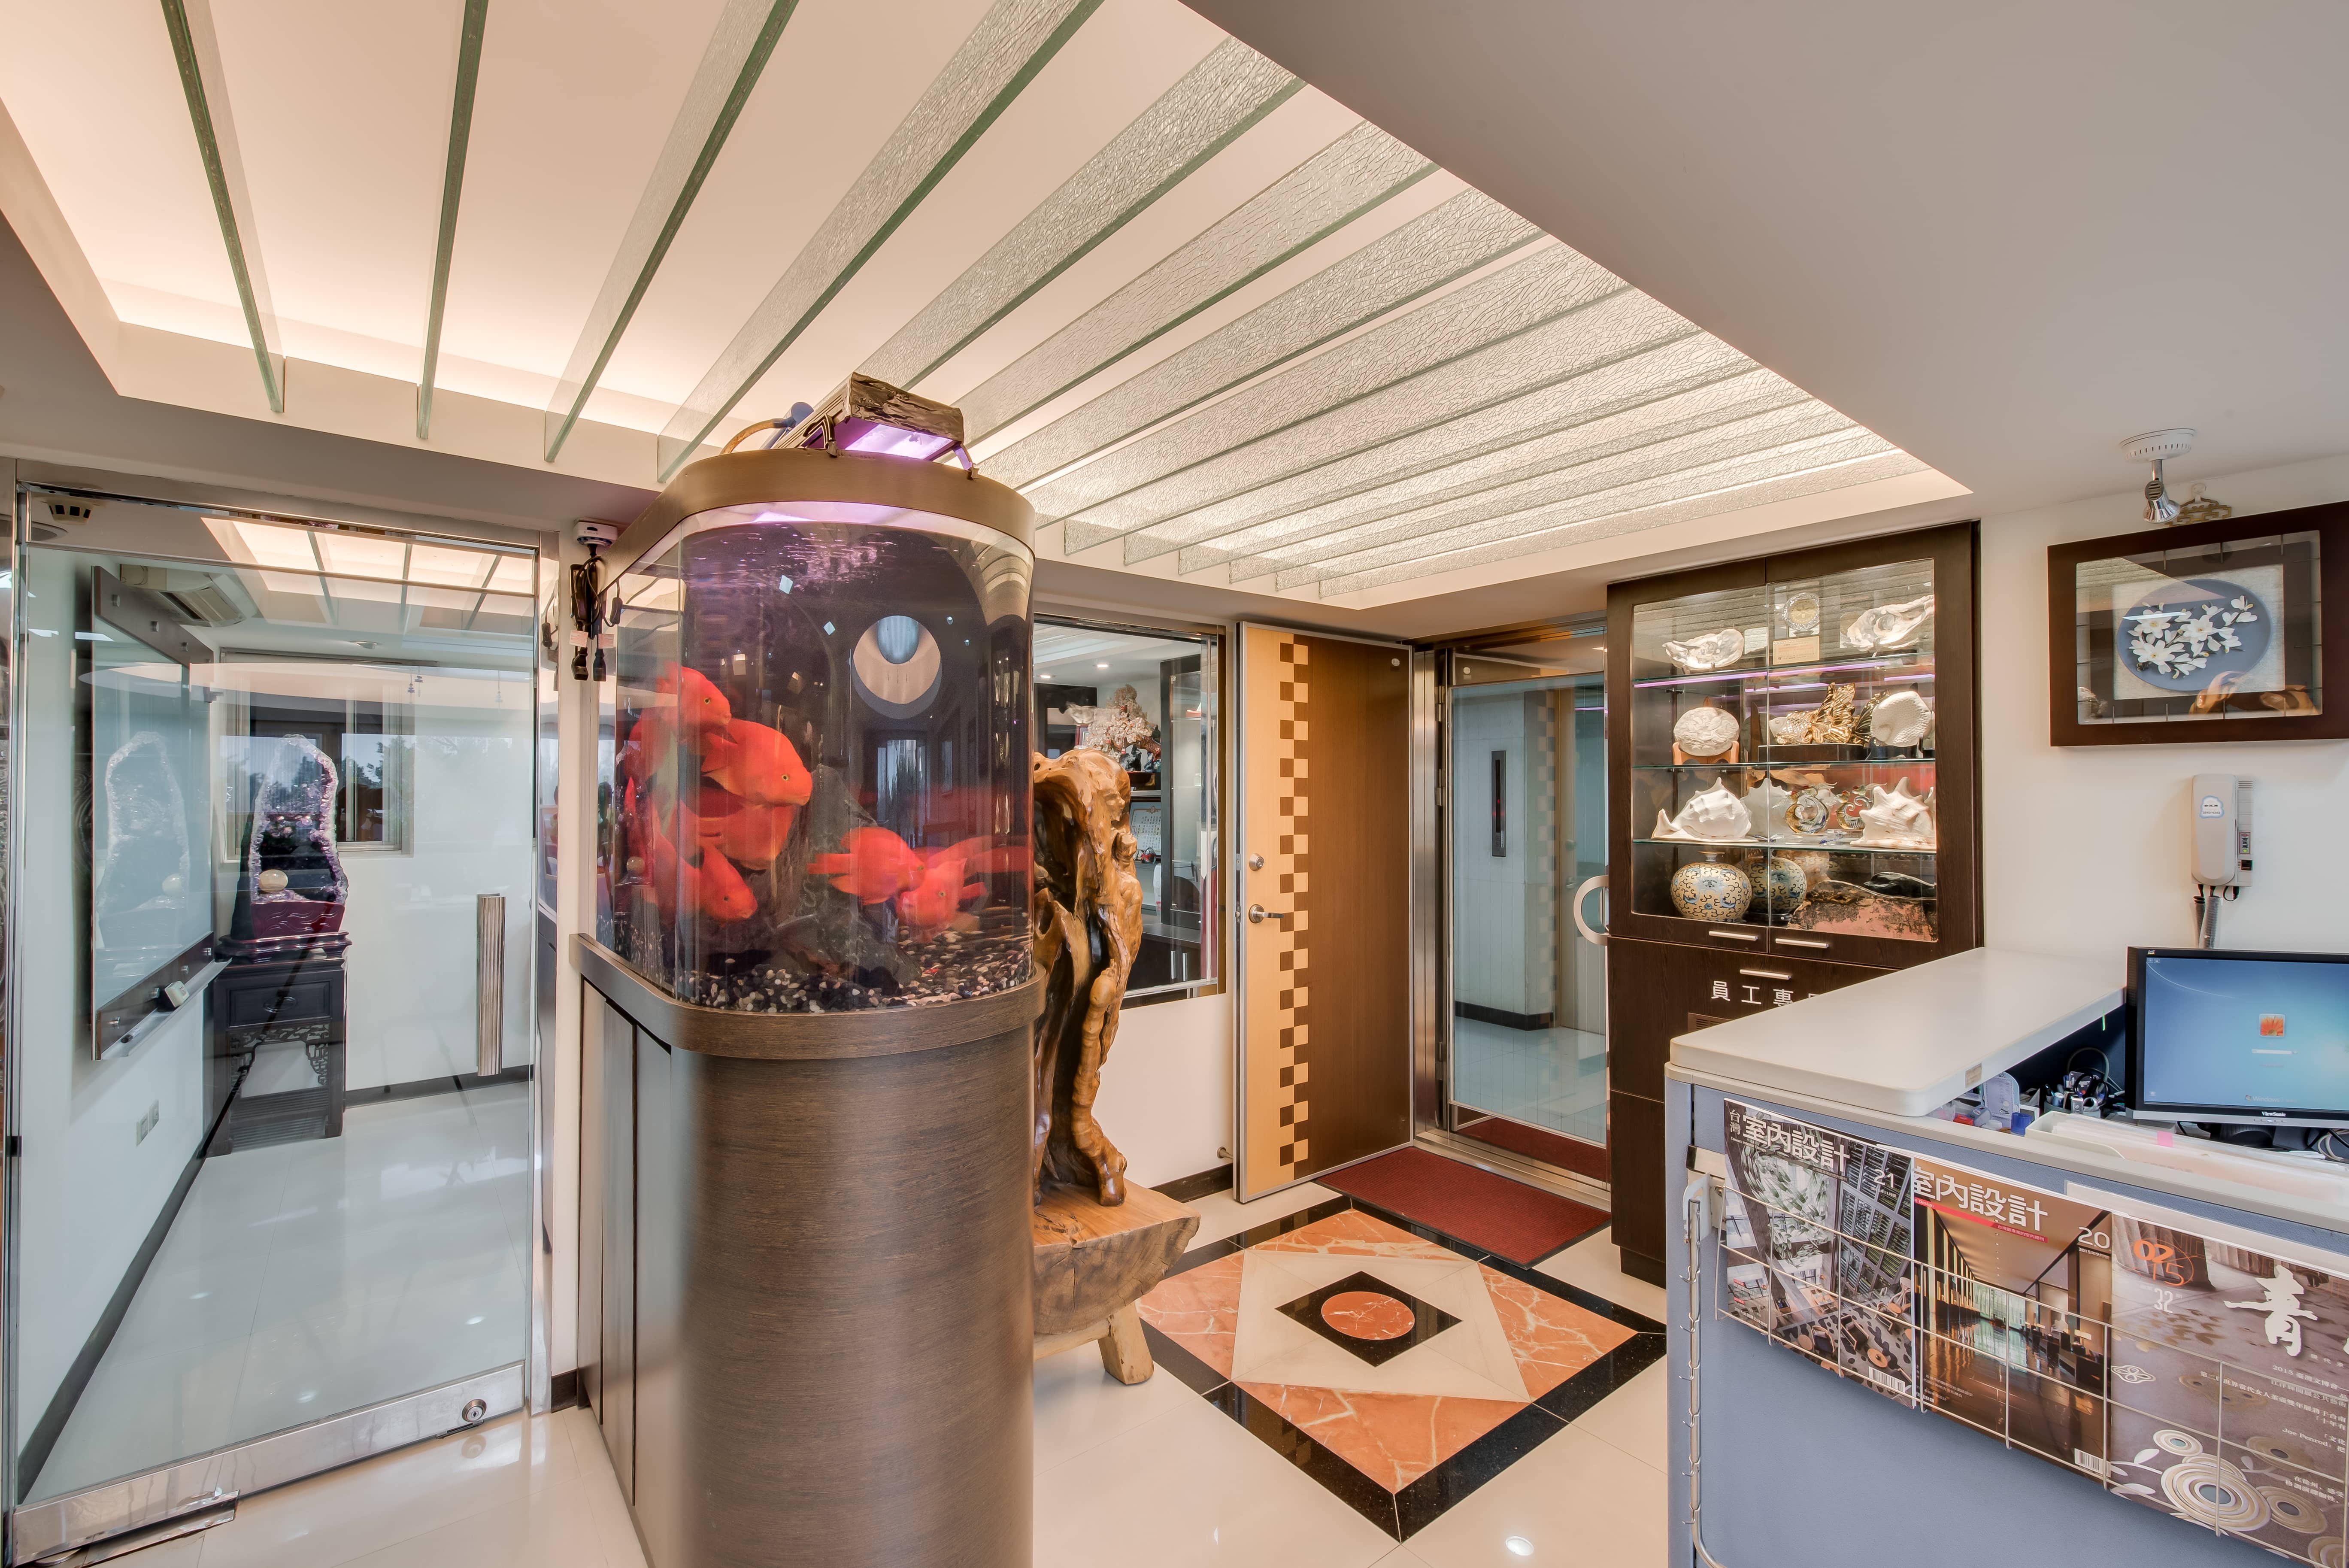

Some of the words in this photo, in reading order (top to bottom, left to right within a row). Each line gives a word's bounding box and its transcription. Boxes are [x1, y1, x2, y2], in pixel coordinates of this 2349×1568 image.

[1711, 980, 1822, 1007] 員工專
[1729, 1109, 1741, 1135] 台灣
[1743, 1114, 1850, 1173] 室內設計
[1874, 1169, 1894, 1188] 21
[1914, 1166, 2048, 1231] 室內設計
[2078, 1227, 2110, 1249] 20
[2133, 1240, 2174, 1264] 02
[2152, 1262, 2184, 1287] 15
[2154, 1288, 2173, 1313] 32
[2273, 1365, 2294, 1376] 2015
[2282, 1428, 2297, 1436] Joe
